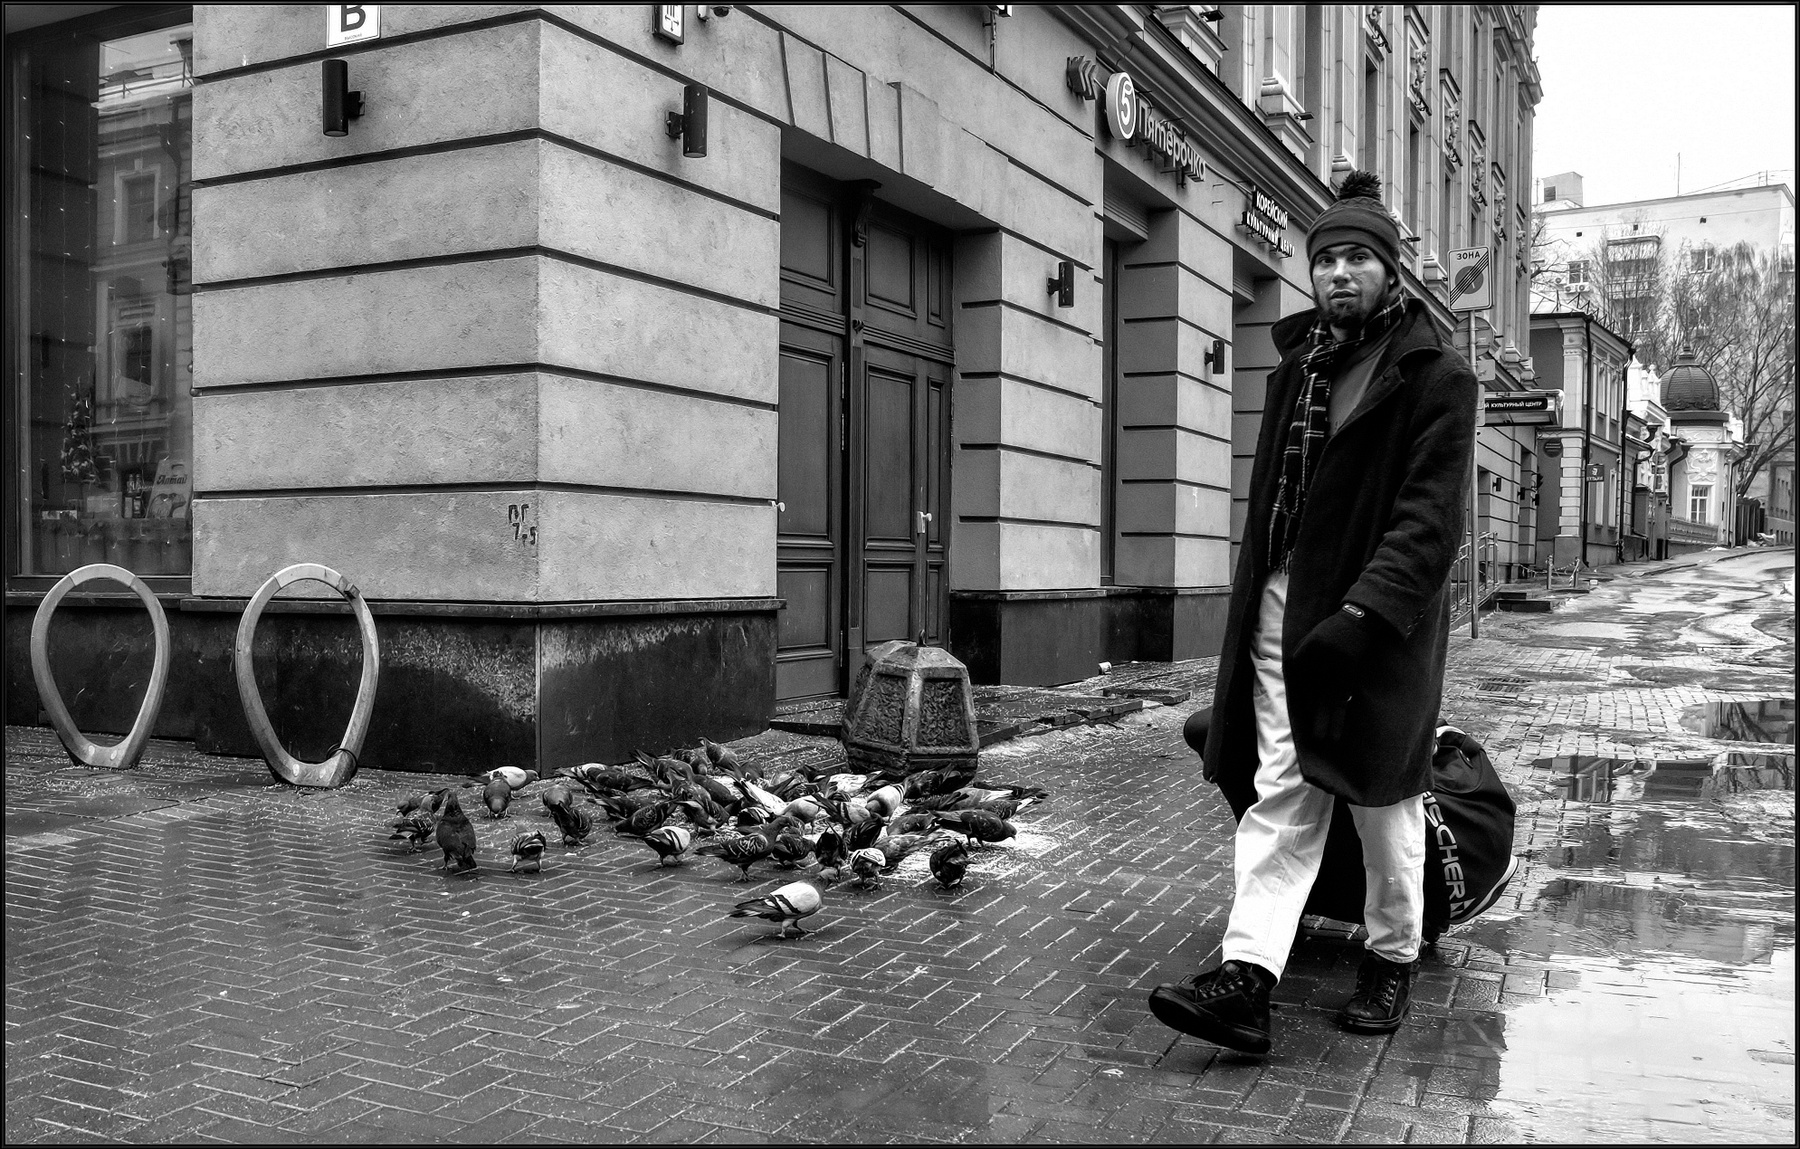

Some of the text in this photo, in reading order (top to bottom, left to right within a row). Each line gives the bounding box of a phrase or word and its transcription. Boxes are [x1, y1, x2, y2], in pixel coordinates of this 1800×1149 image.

[1138, 97, 1206, 182] Пятёрочка
[1256, 190, 1288, 231] КОРЕЙСКИЙ
[1456, 251, 1481, 261] ЗОНА
[1490, 401, 1525, 409] КУЛЬТУРНЫЙ
[1423, 790, 1466, 901] ISCHER
